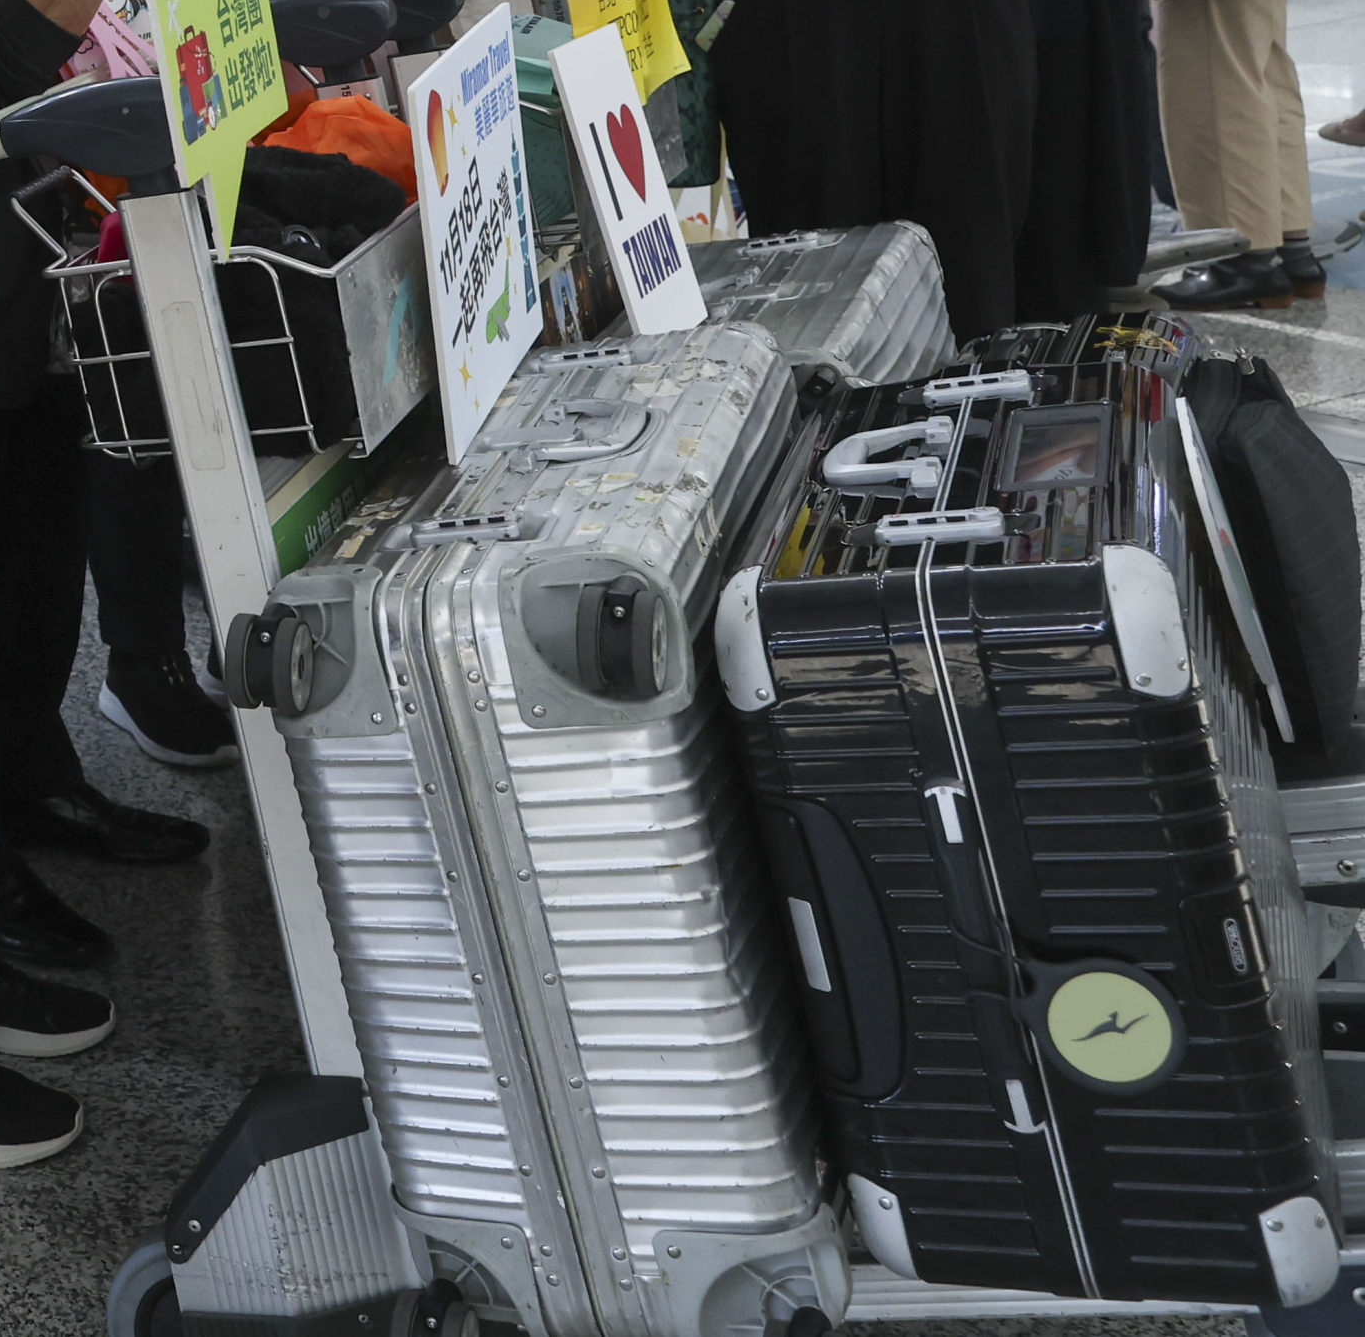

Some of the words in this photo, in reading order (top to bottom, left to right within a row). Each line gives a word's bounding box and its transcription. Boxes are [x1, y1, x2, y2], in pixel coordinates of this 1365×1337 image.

[224, 35, 277, 113] 出發啦!
[460, 54, 490, 107] Miramar
[488, 30, 511, 78] Travel
[474, 72, 516, 147] 美麗華旅遊
[588, 121, 624, 222] I
[439, 154, 483, 296] 11月18日
[451, 163, 513, 350] 一起再飛台灣
[621, 212, 682, 300] TAIWAN
